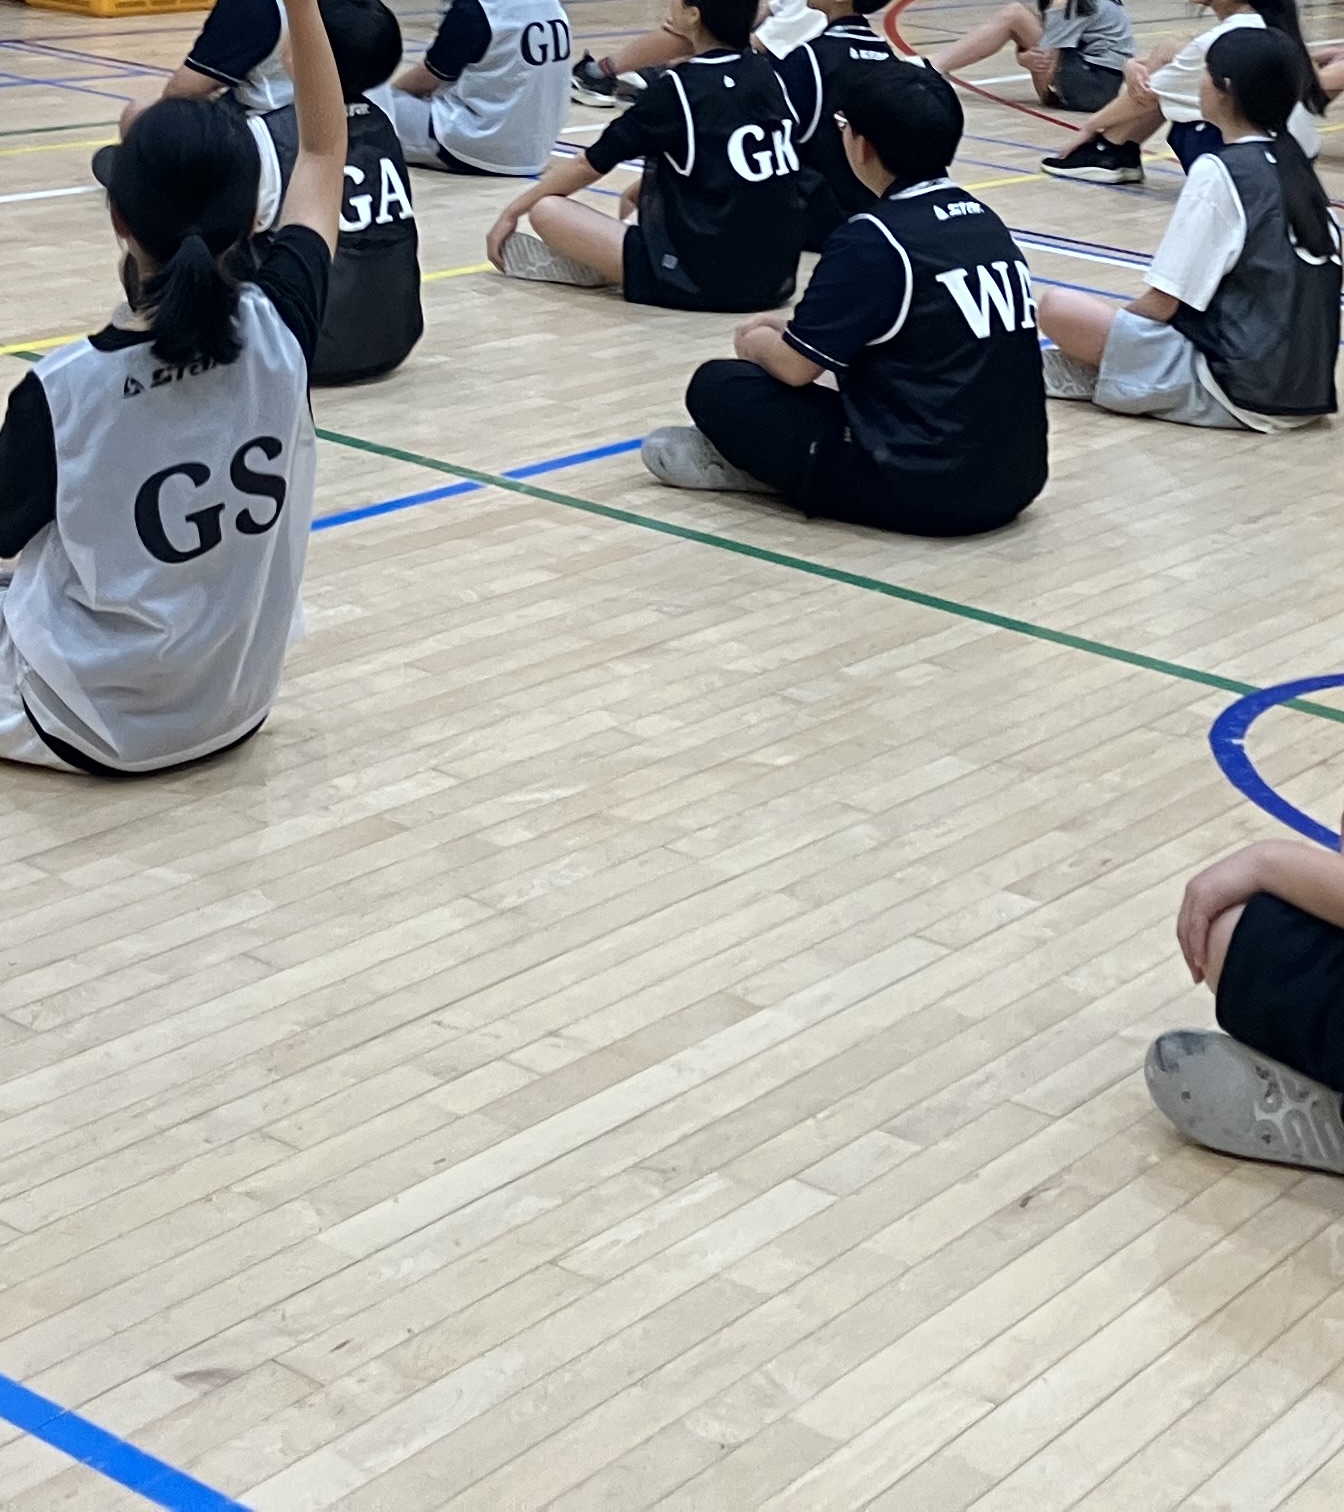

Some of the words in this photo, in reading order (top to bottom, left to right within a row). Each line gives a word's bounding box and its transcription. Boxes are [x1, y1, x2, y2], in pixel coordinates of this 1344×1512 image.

[521, 18, 571, 67] GD
[339, 157, 414, 232] GA
[134, 436, 287, 564] GS
